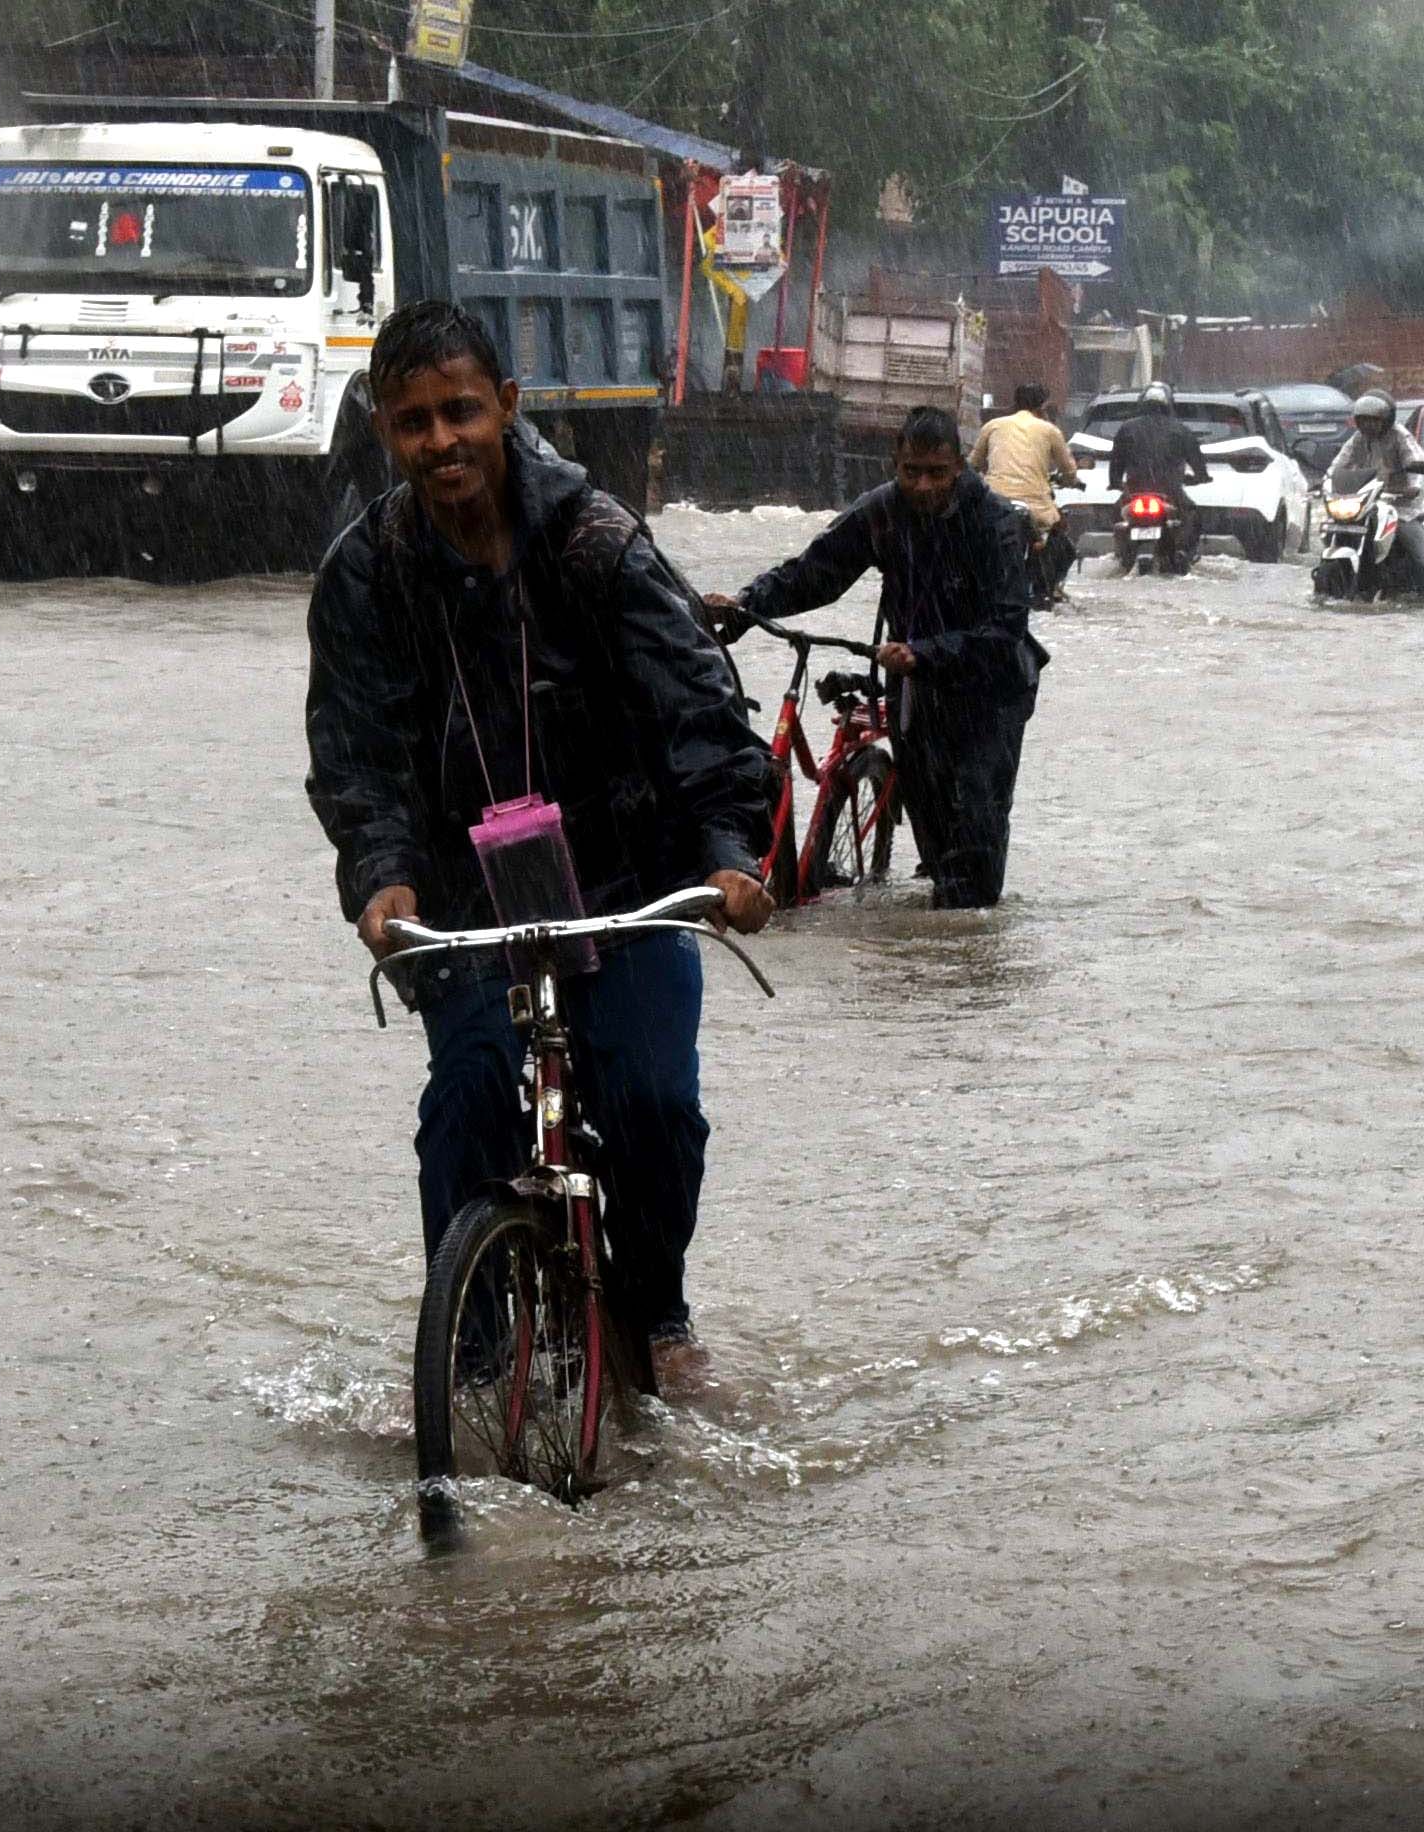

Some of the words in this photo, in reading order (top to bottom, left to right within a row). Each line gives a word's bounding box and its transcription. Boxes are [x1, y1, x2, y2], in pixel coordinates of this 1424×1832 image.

[4, 171, 51, 185] JAI
[61, 171, 107, 185] MA
[122, 172, 250, 188] CHANDRIKE
[998, 205, 1114, 225] JAIPURIA
[1005, 225, 1108, 244] SCHOOL
[87, 348, 132, 361] TATA
